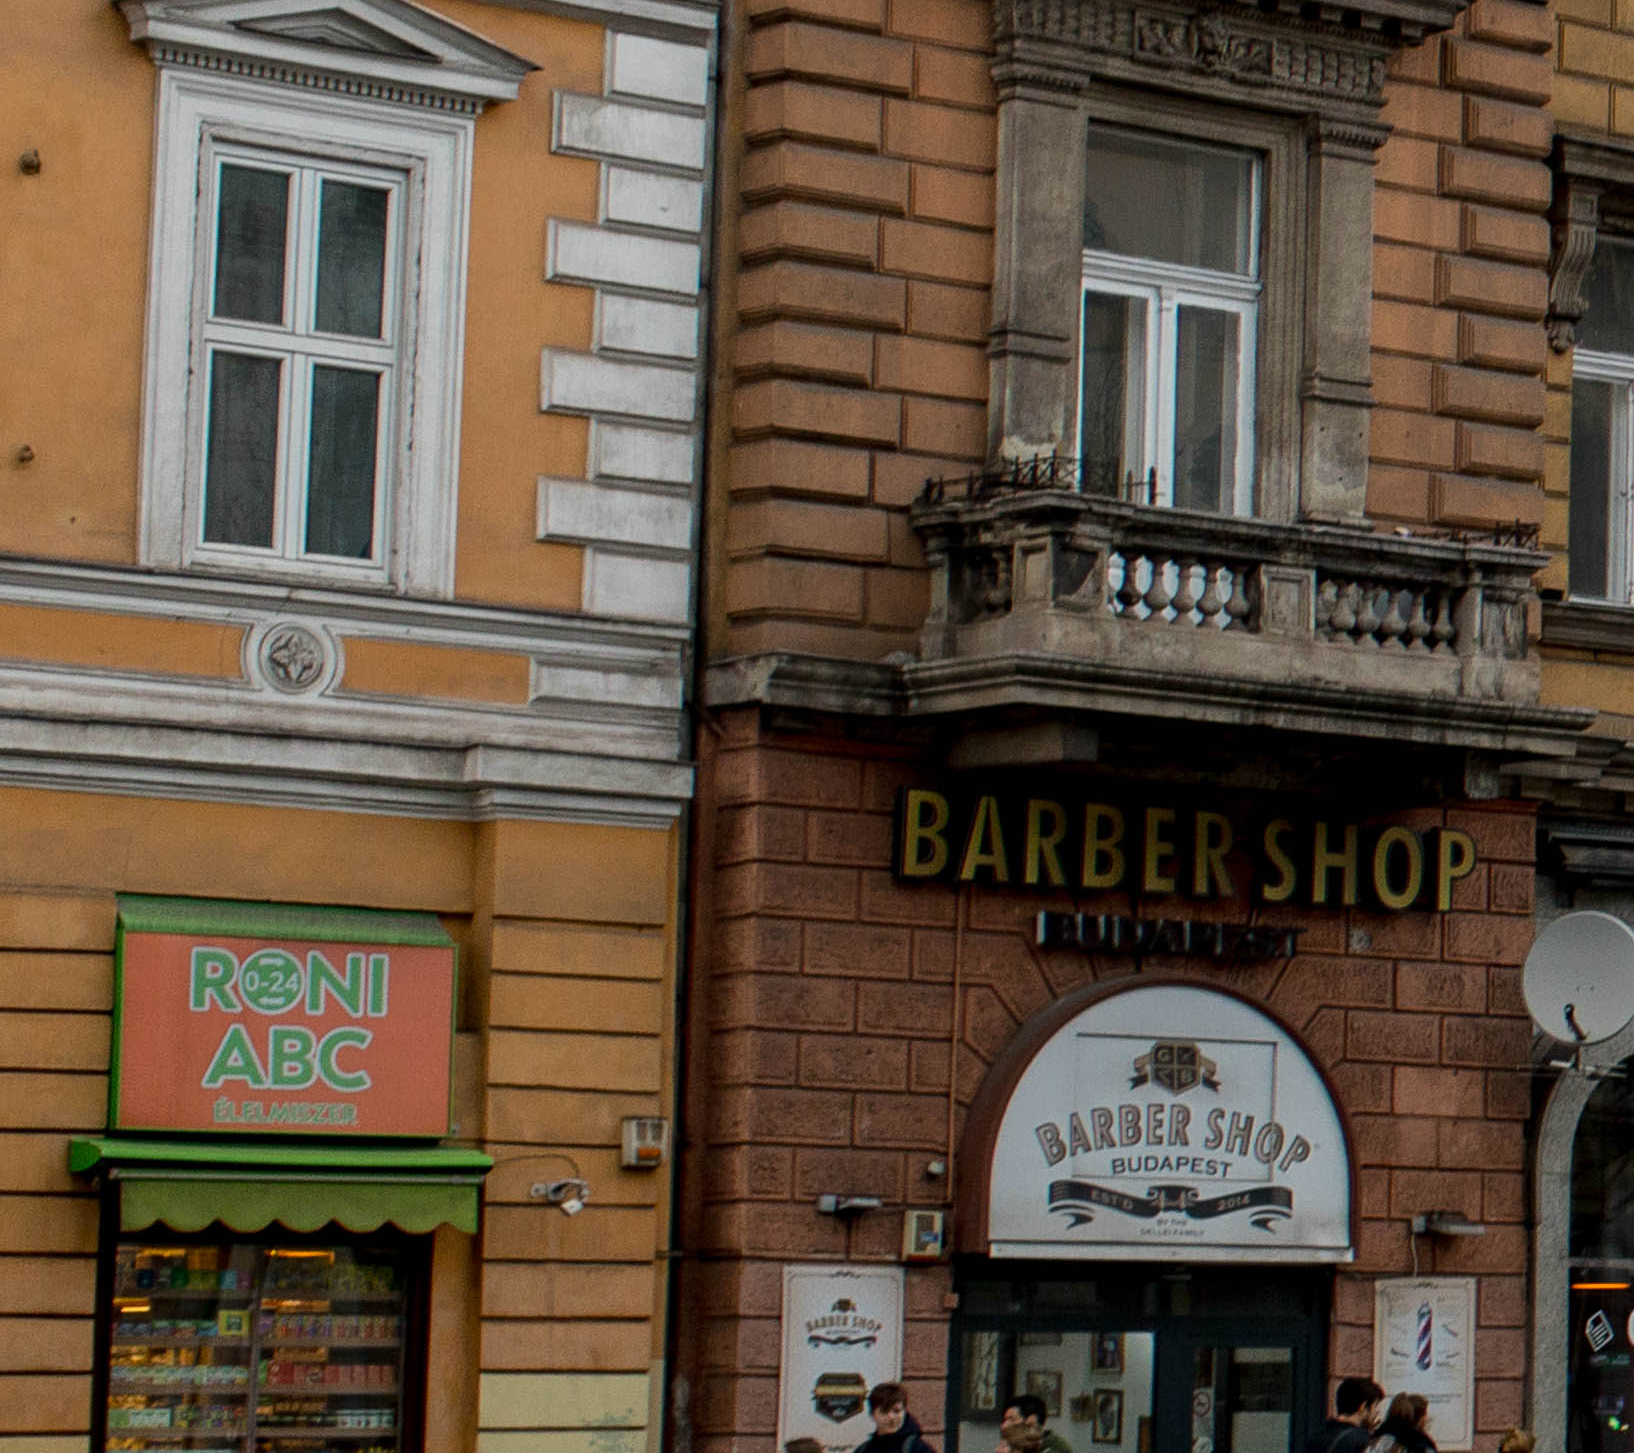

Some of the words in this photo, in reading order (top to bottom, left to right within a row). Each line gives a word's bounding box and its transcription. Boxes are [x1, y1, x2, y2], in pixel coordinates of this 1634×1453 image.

[902, 789, 1235, 897] BARBER
[1262, 820, 1478, 912] SHOP
[190, 945, 390, 1018] RONI
[244, 969, 300, 994] 0-24
[202, 1023, 374, 1093] ABC
[213, 1096, 359, 1126] ÉLELMISZER
[1035, 1103, 1191, 1168] BARBER
[1204, 1108, 1312, 1172] SHOP
[1111, 1155, 1233, 1178] BUDAPEST
